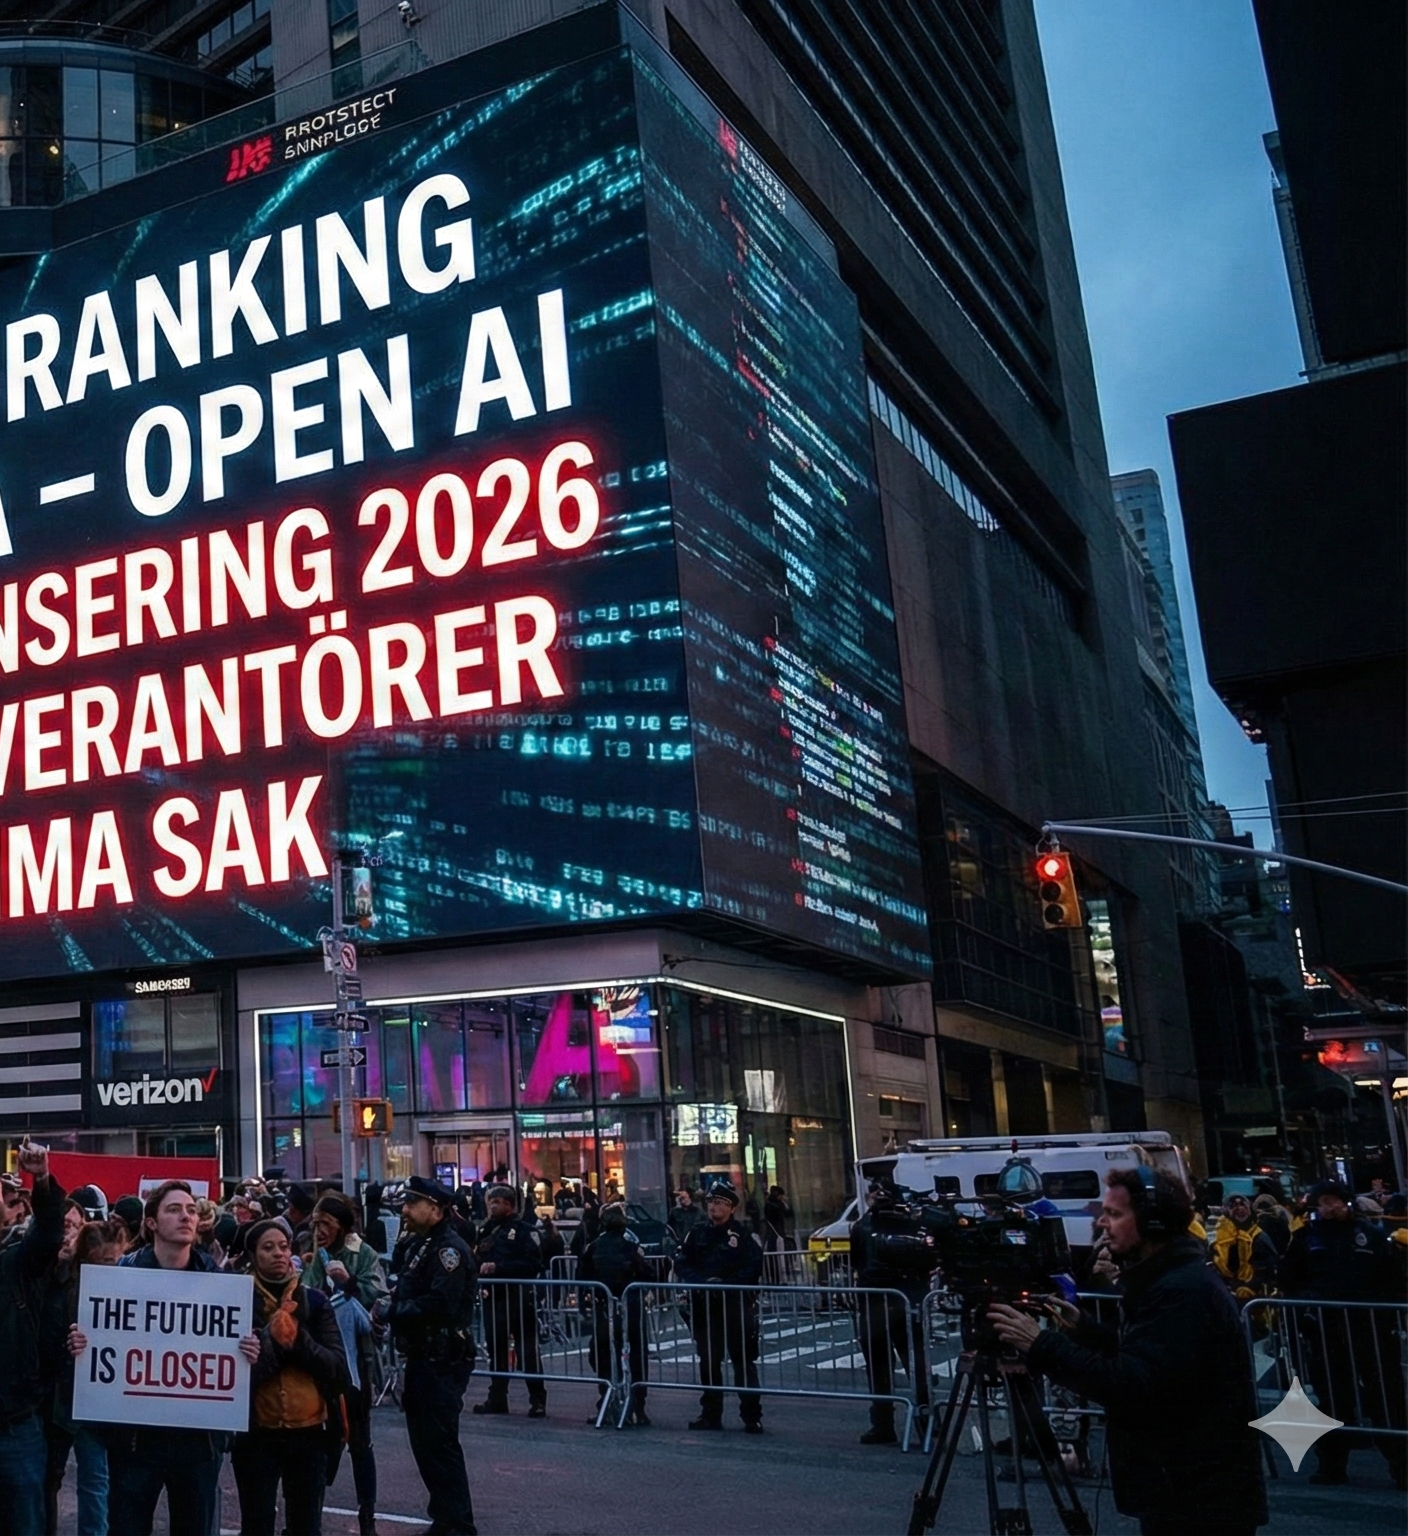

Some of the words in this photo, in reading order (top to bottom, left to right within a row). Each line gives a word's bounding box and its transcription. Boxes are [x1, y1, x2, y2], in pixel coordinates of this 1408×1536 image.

[125, 334, 415, 517] OPEN
[454, 288, 573, 437] AI
[357, 441, 600, 594] 2026
[151, 775, 329, 898] SAK
[97, 1073, 203, 1106] verizon
[89, 1296, 138, 1331] THE
[145, 1300, 241, 1339] FUTURE
[90, 1346, 117, 1384] IS
[125, 1348, 236, 1391] CLOSED
